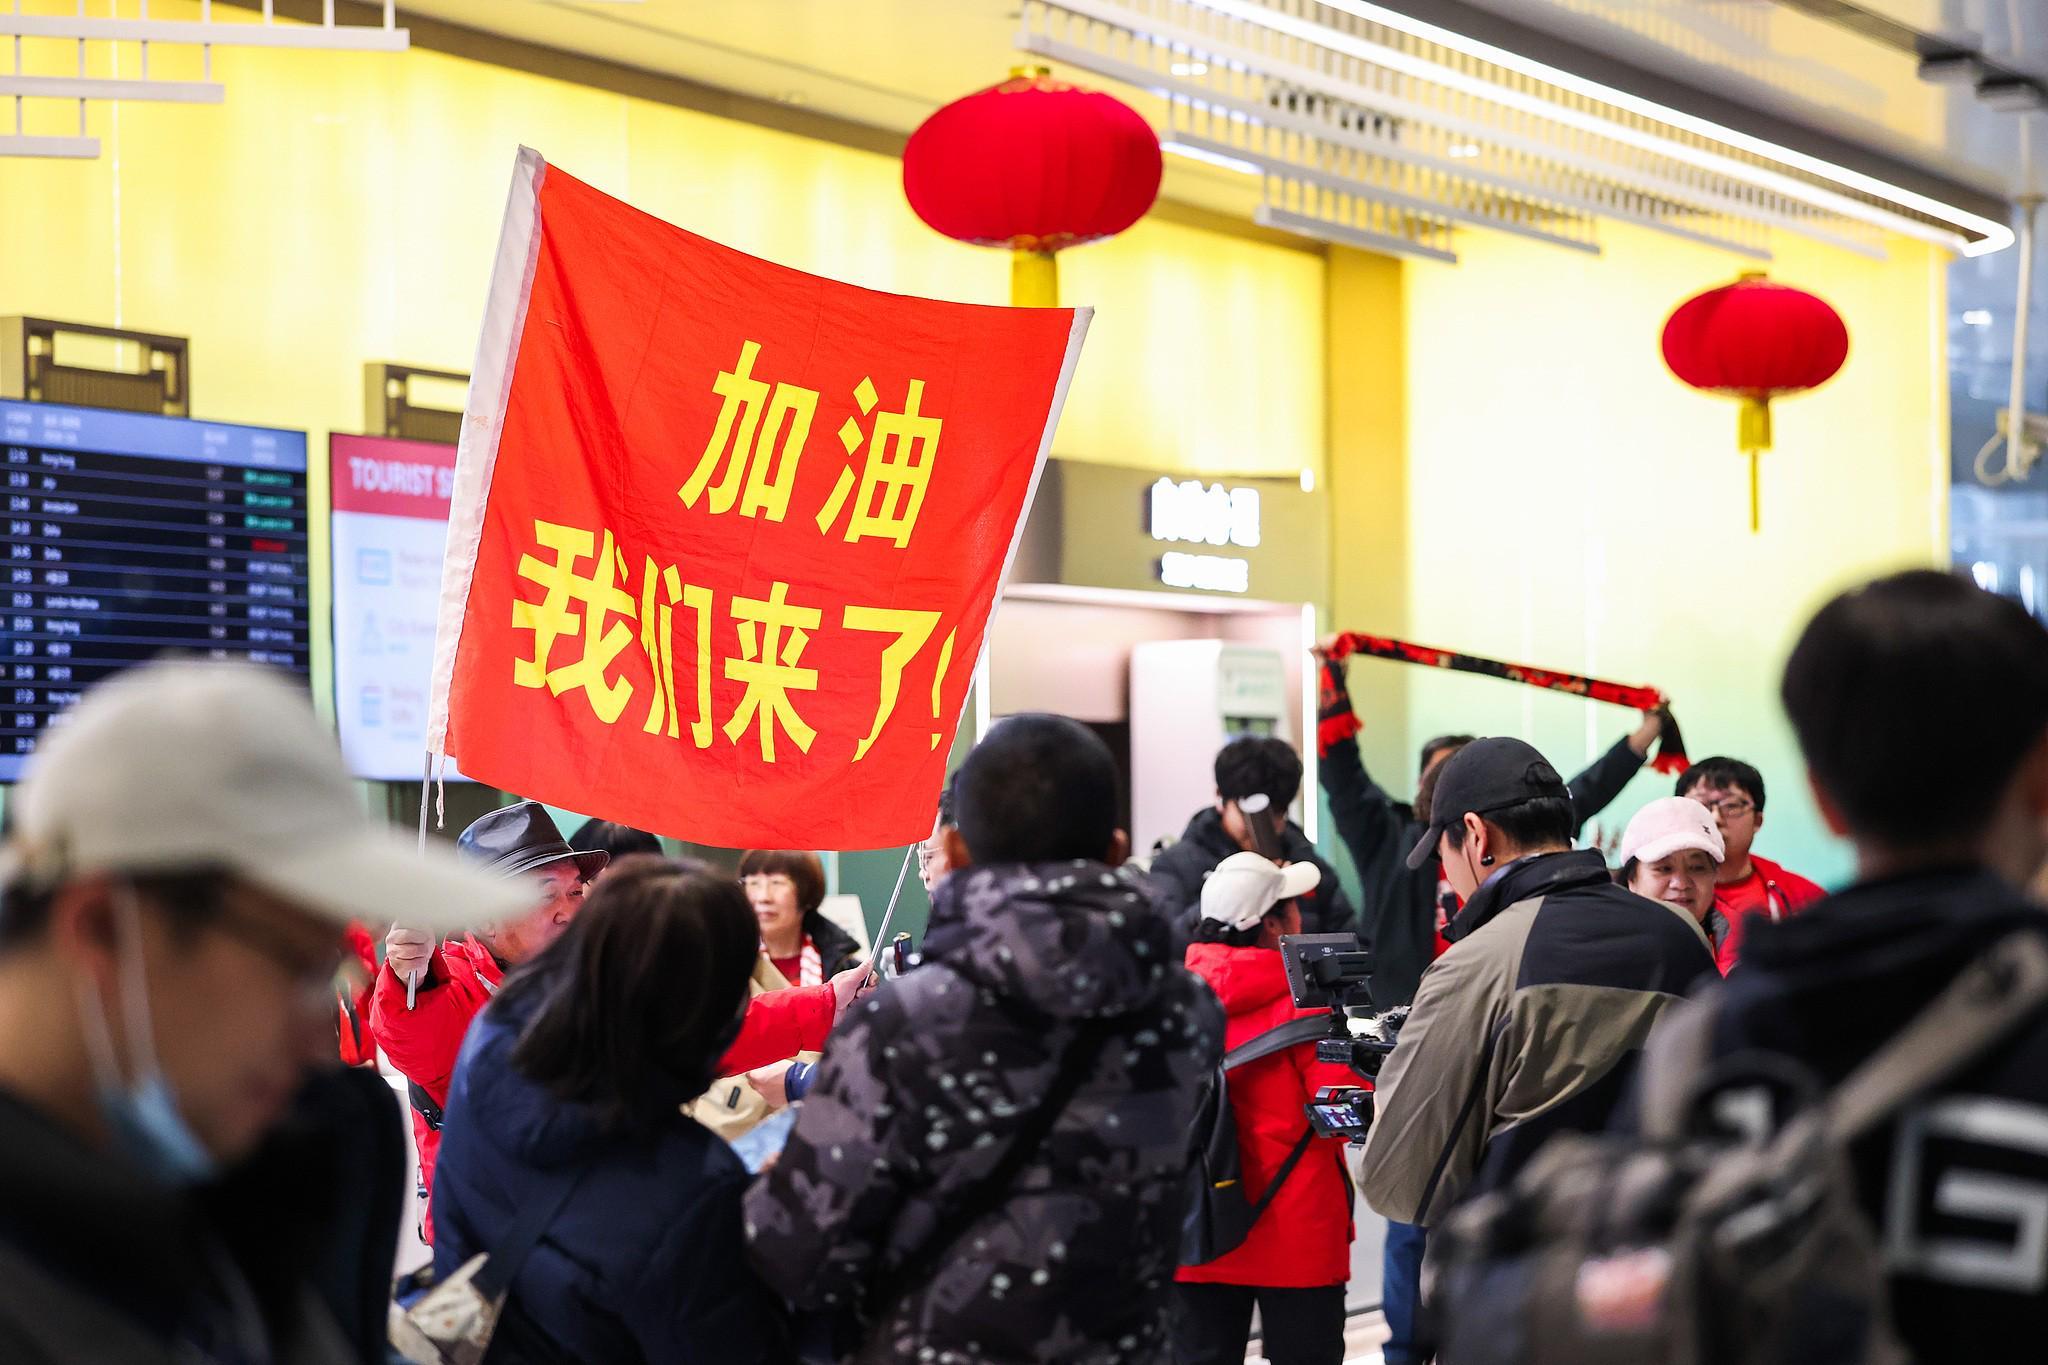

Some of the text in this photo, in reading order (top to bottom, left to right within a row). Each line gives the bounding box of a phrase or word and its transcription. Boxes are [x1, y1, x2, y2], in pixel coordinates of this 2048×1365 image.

[349, 456, 434, 496] TOURIST
[677, 339, 944, 549] 加油
[511, 519, 958, 763] 我们来了!
